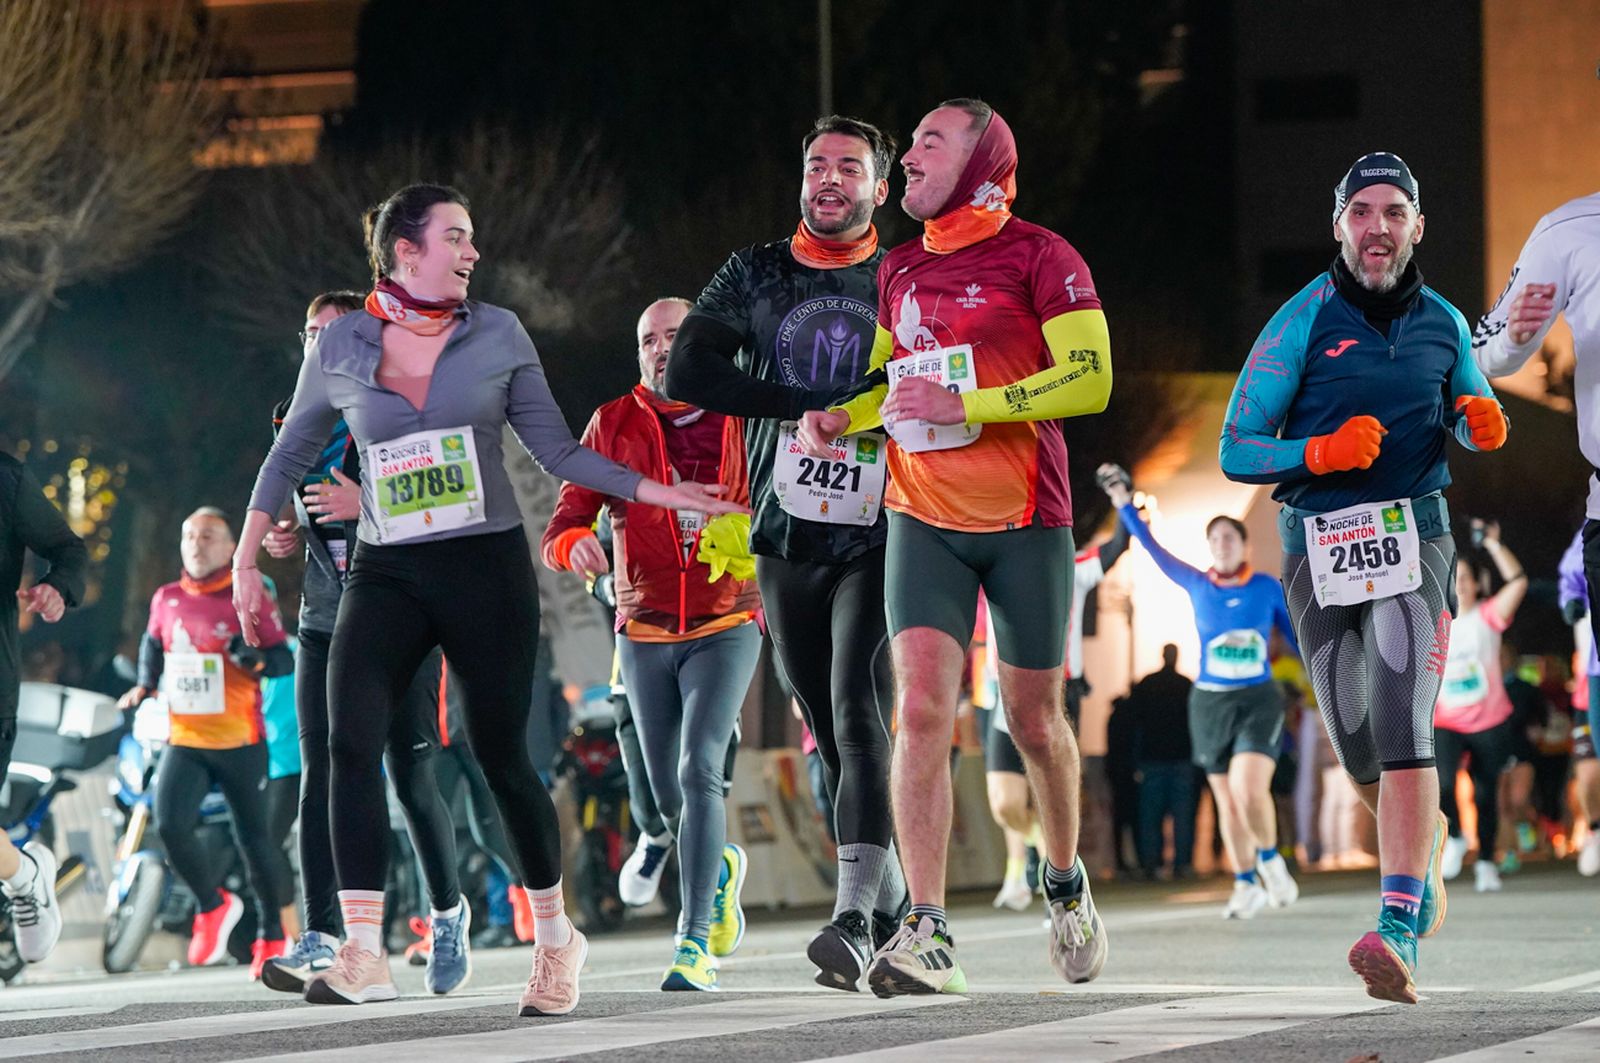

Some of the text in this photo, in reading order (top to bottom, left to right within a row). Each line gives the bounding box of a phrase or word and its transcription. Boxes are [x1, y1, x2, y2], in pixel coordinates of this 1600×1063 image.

[781, 321, 796, 342] EME
[793, 300, 824, 322] CENTRO
[826, 300, 839, 309] DE
[931, 362, 943, 371] DE
[789, 443, 806, 455] SA
[836, 437, 849, 448] DE
[391, 445, 417, 461] NOCHE
[419, 444, 431, 455] DE
[382, 464, 400, 477] SAN
[796, 457, 862, 492] 2421
[386, 463, 465, 506] 13789
[808, 489, 827, 498] Pedro
[687, 520, 697, 529] DE
[1329, 517, 1360, 531] NOCHE
[1361, 514, 1373, 525] DE
[1319, 533, 1340, 546] SAN
[1342, 525, 1376, 543] ANTÓN
[1330, 536, 1401, 574] 2458
[1348, 573, 1364, 582] José
